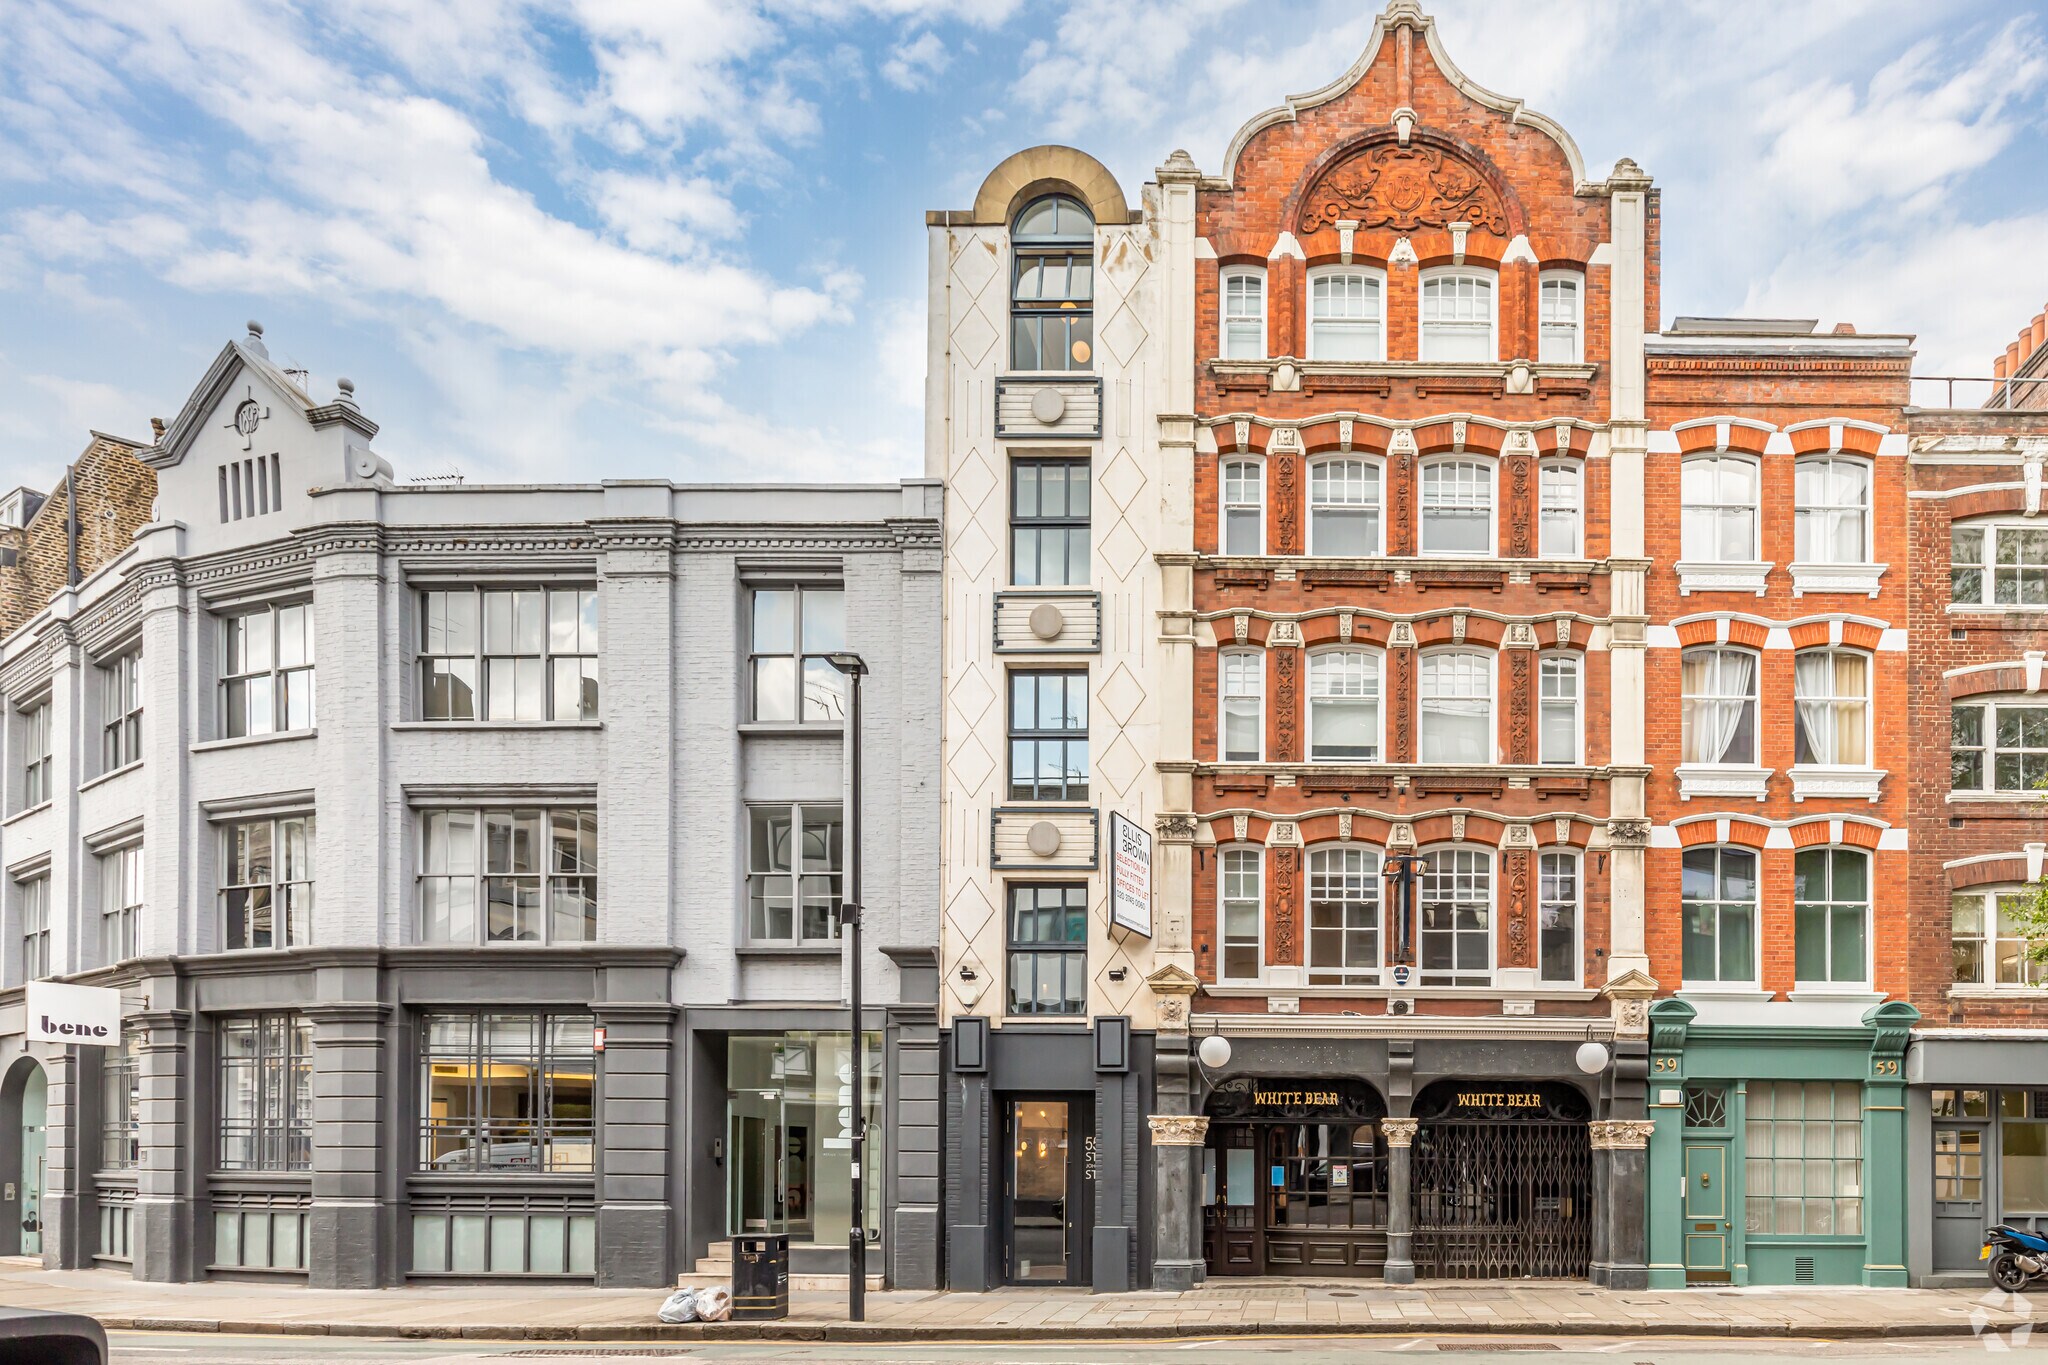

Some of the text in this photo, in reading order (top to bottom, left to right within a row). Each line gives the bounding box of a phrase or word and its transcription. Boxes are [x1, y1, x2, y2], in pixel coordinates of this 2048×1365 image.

[1122, 824, 1142, 846] ELLIS
[1116, 851, 1147, 875] SELECTION OF
[1116, 864, 1144, 887] FULLY FITTED
[1116, 877, 1135, 894] OFFICES
[1135, 887, 1141, 897] TO
[41, 1015, 108, 1037] bene
[1654, 1057, 1677, 1072] 59
[1874, 1061, 1898, 1075] 59
[1254, 1091, 1338, 1106] WHITE BEAR
[1457, 1093, 1541, 1107] WHITE BEAR
